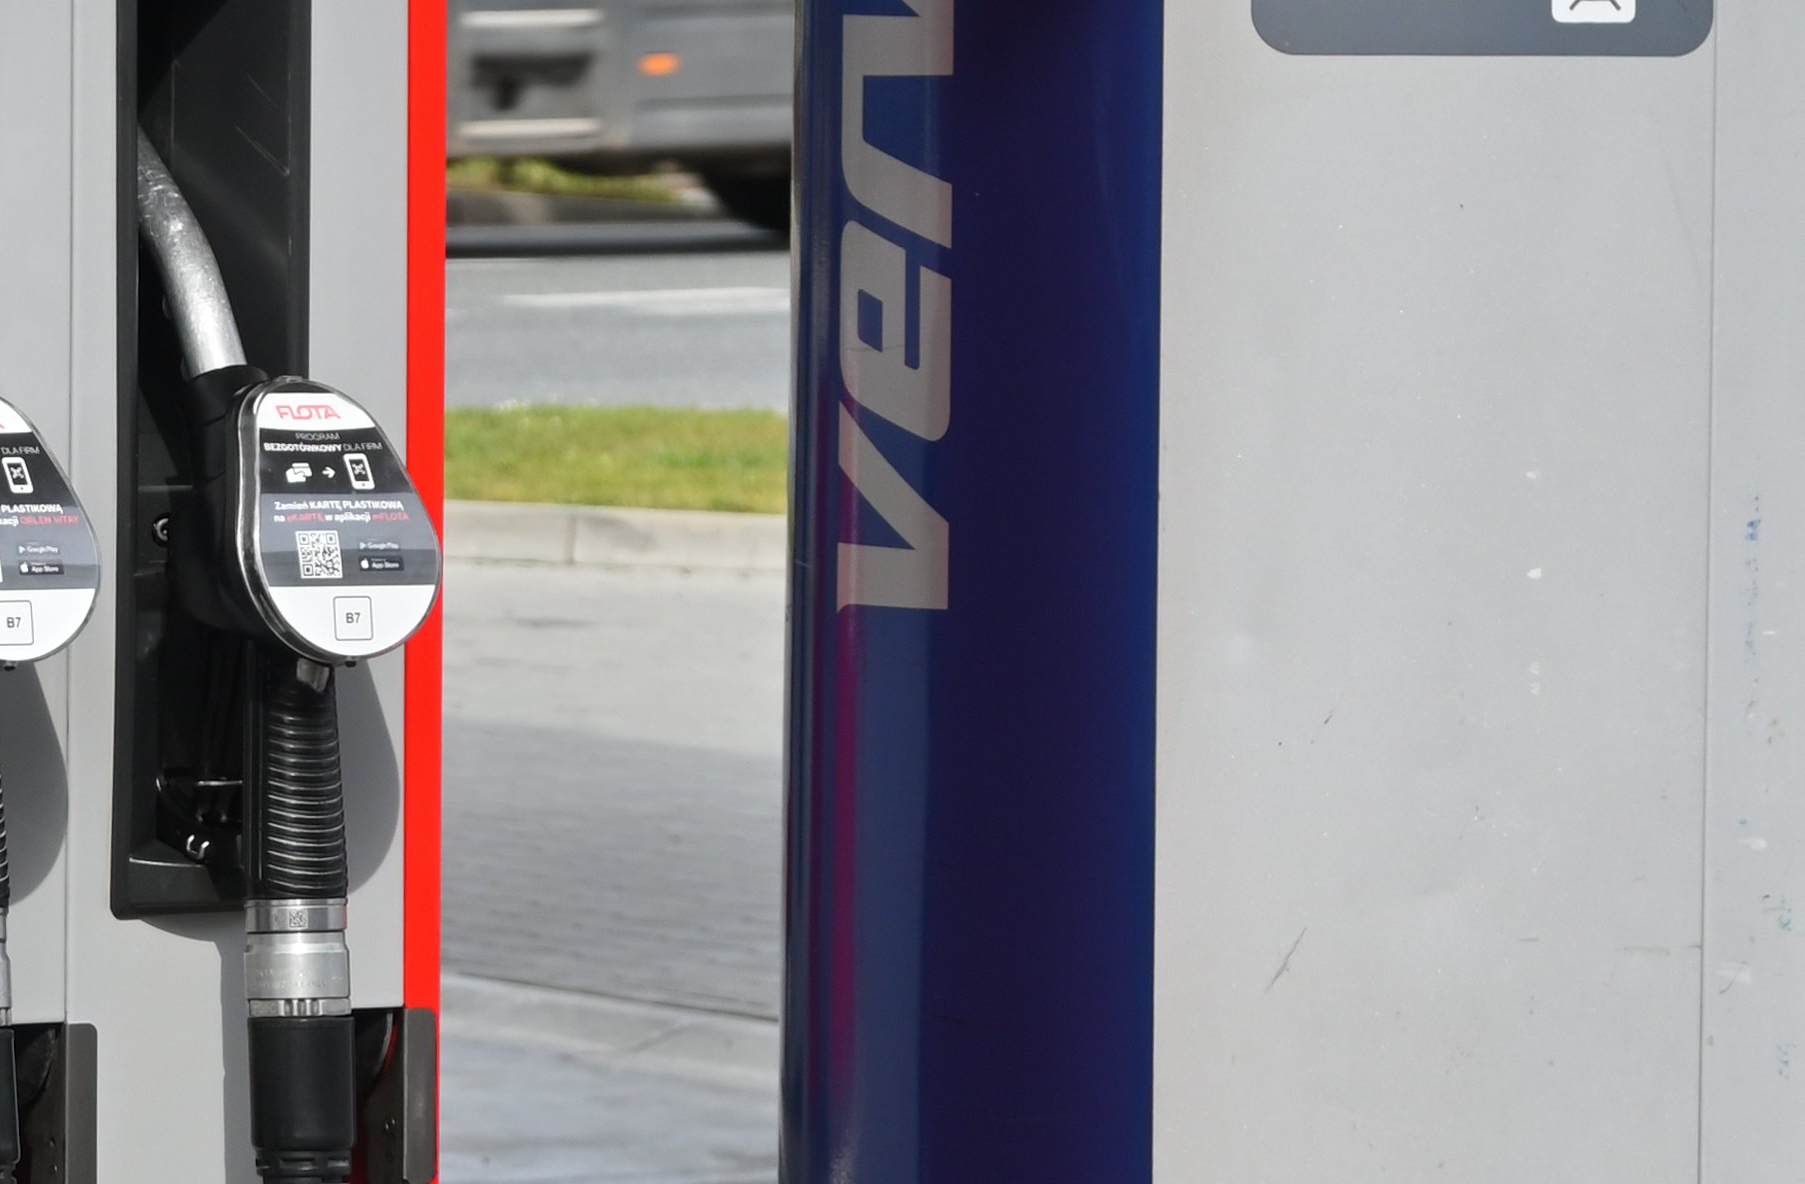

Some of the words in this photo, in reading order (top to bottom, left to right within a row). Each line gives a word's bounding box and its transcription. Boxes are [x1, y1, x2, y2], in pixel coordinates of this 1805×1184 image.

[276, 405, 341, 420] FLOTA
[6, 617, 21, 628] B7
[346, 612, 360, 623] B7
